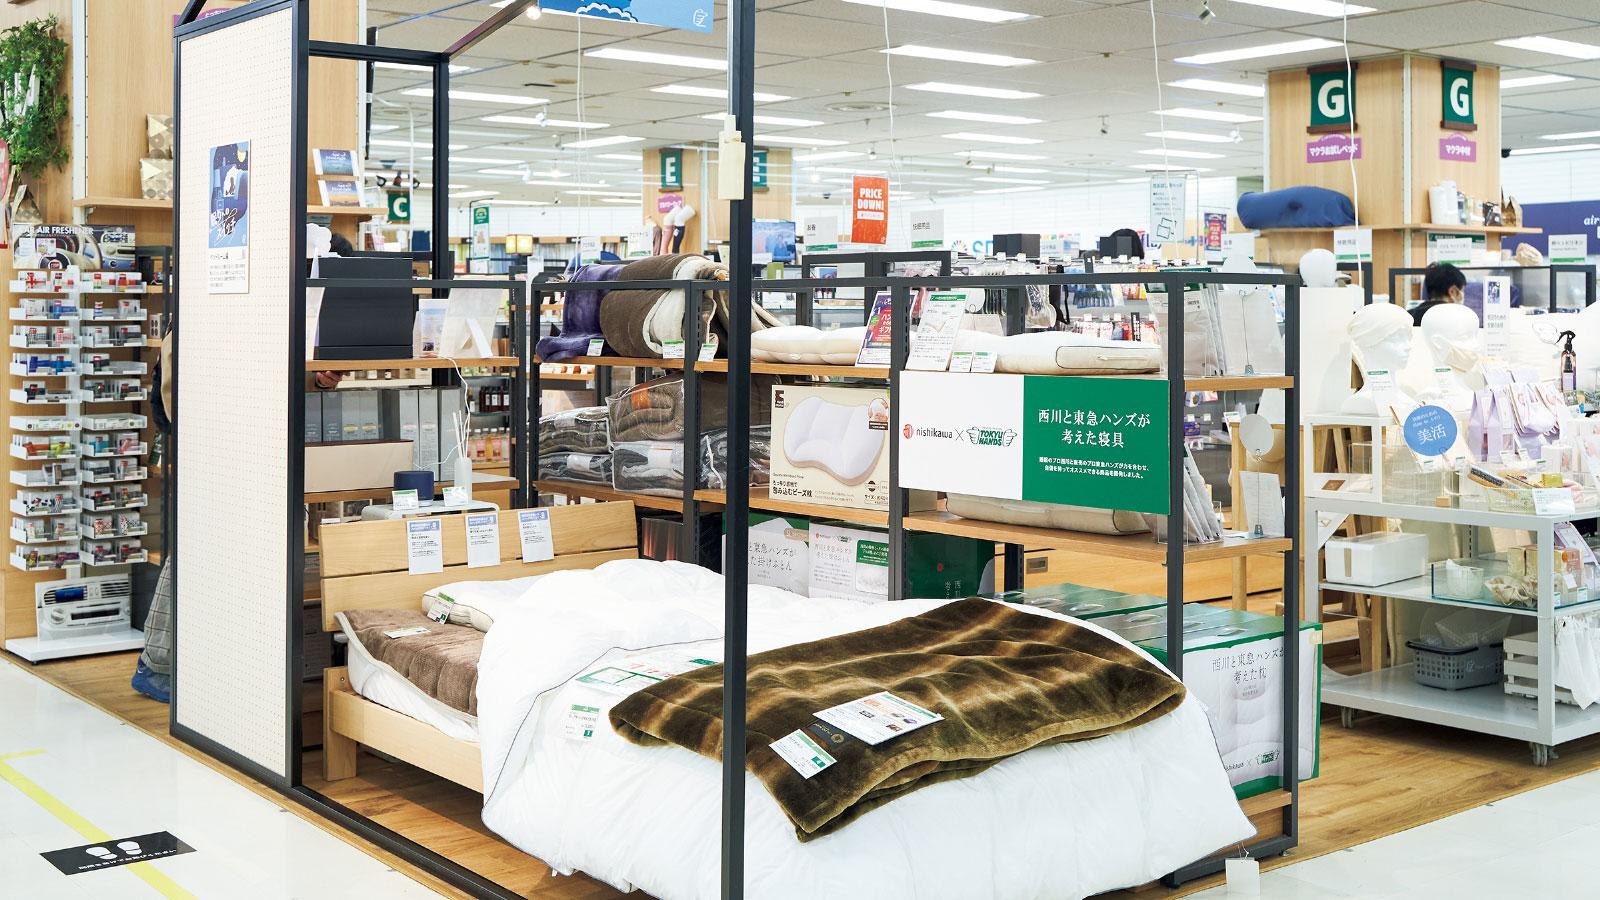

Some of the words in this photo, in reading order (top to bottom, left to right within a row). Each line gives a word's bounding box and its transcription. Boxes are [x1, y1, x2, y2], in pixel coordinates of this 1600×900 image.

[1317, 79, 1345, 118] G
[1450, 77, 1469, 117] G
[665, 157, 676, 183] E
[859, 187, 883, 199] PRICE
[393, 197, 408, 217] C
[857, 199, 884, 211] DOWN!
[36, 226, 50, 234] AIR
[1038, 408, 1151, 428] 西川と東急ハンズが
[916, 427, 953, 439] nishikawa
[980, 430, 1003, 439] TOKYU
[979, 438, 1002, 447] HANDS
[1061, 429, 1124, 448] 考えた寝具
[1416, 423, 1447, 445] 美活
